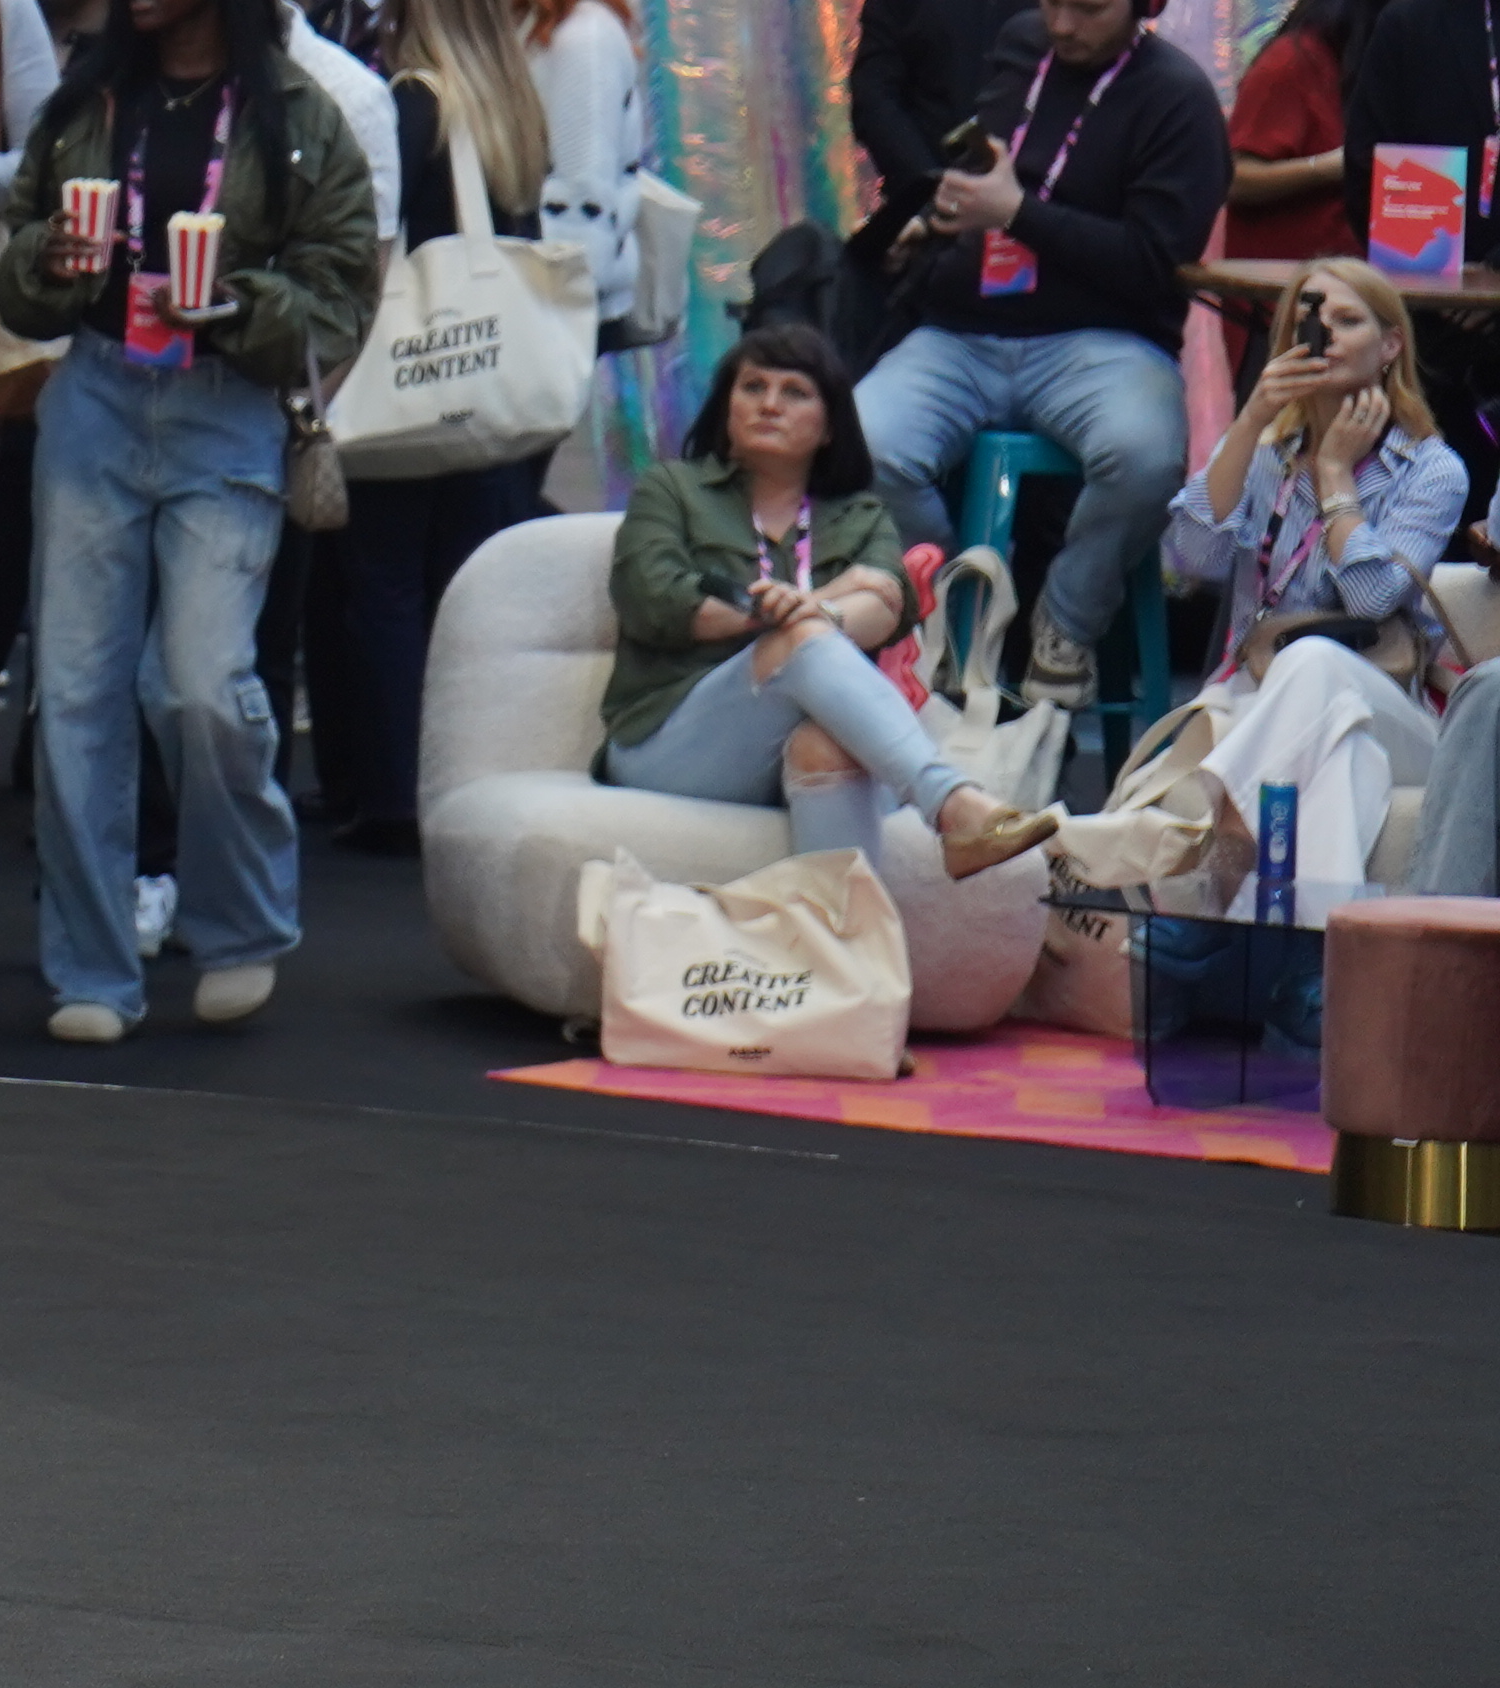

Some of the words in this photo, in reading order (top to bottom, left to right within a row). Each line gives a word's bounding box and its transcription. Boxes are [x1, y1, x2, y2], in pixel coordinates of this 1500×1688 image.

[390, 314, 501, 362] CREATIVE
[394, 343, 502, 389] CONTENT
[682, 960, 813, 989] CREATIVE
[682, 987, 810, 1017] CONTENT
